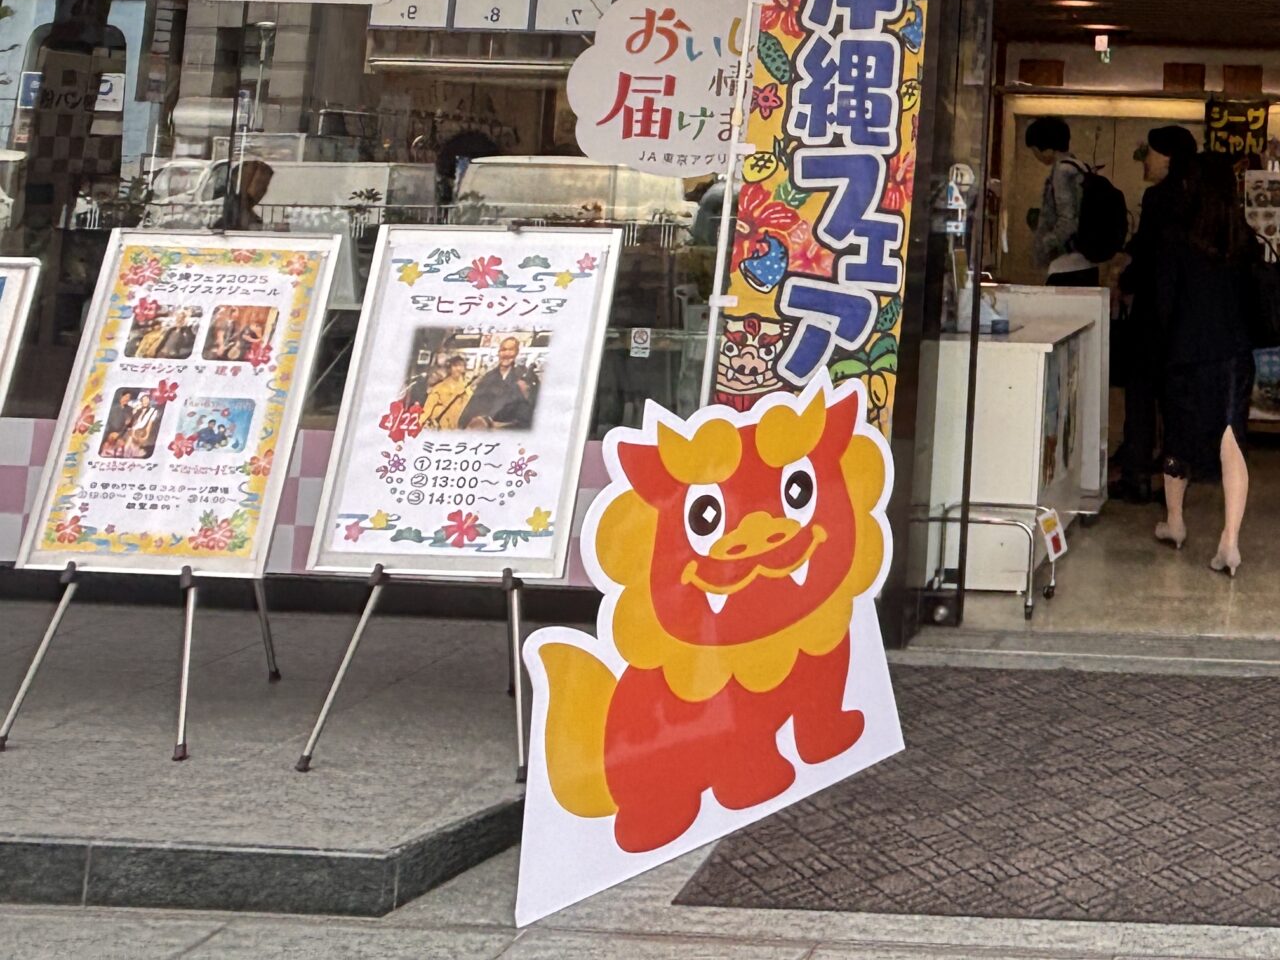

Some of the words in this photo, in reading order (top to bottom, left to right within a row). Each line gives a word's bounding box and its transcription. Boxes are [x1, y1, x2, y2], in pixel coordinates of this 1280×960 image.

[422, 440, 501, 454] ミニライブ
